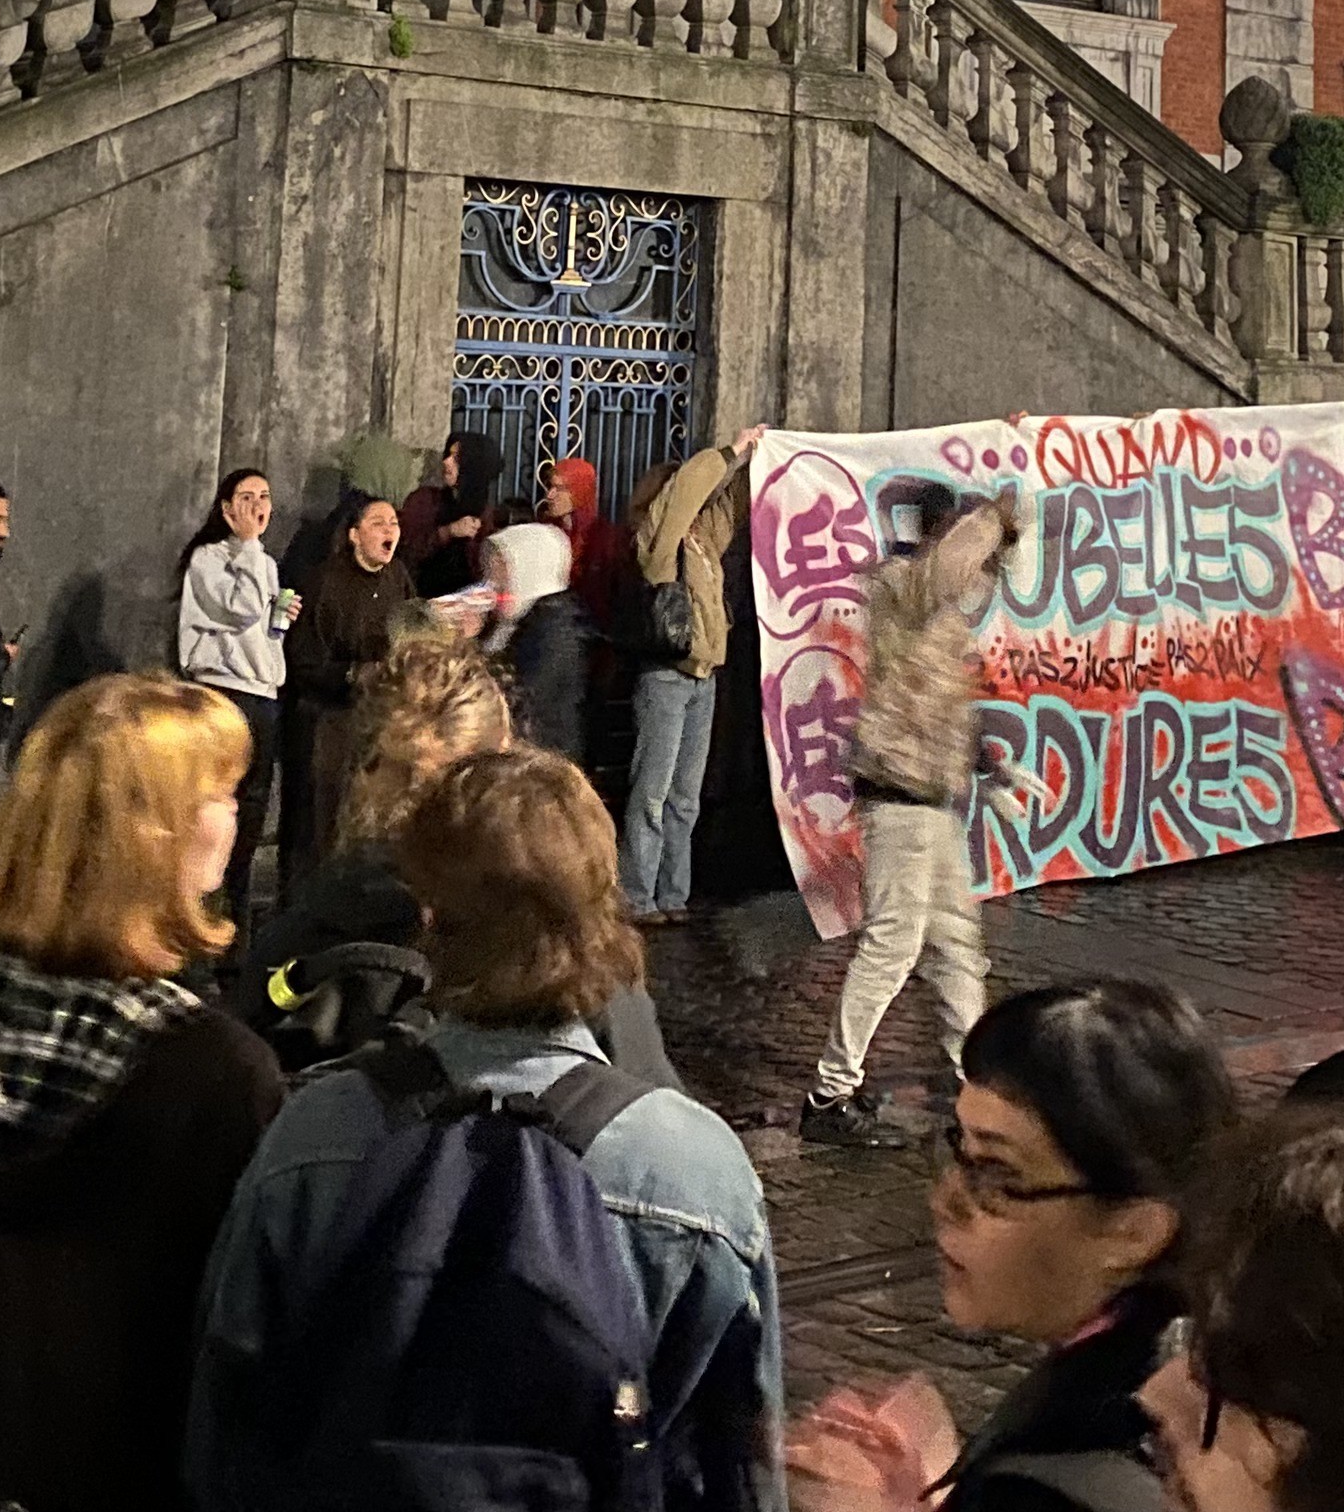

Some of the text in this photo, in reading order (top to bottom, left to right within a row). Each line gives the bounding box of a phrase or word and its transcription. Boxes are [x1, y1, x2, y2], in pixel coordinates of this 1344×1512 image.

[1036, 409, 1222, 488] QUAND
[751, 492, 878, 600] LES
[865, 463, 1291, 636] UBELLES
[954, 691, 1297, 892] RDURES
